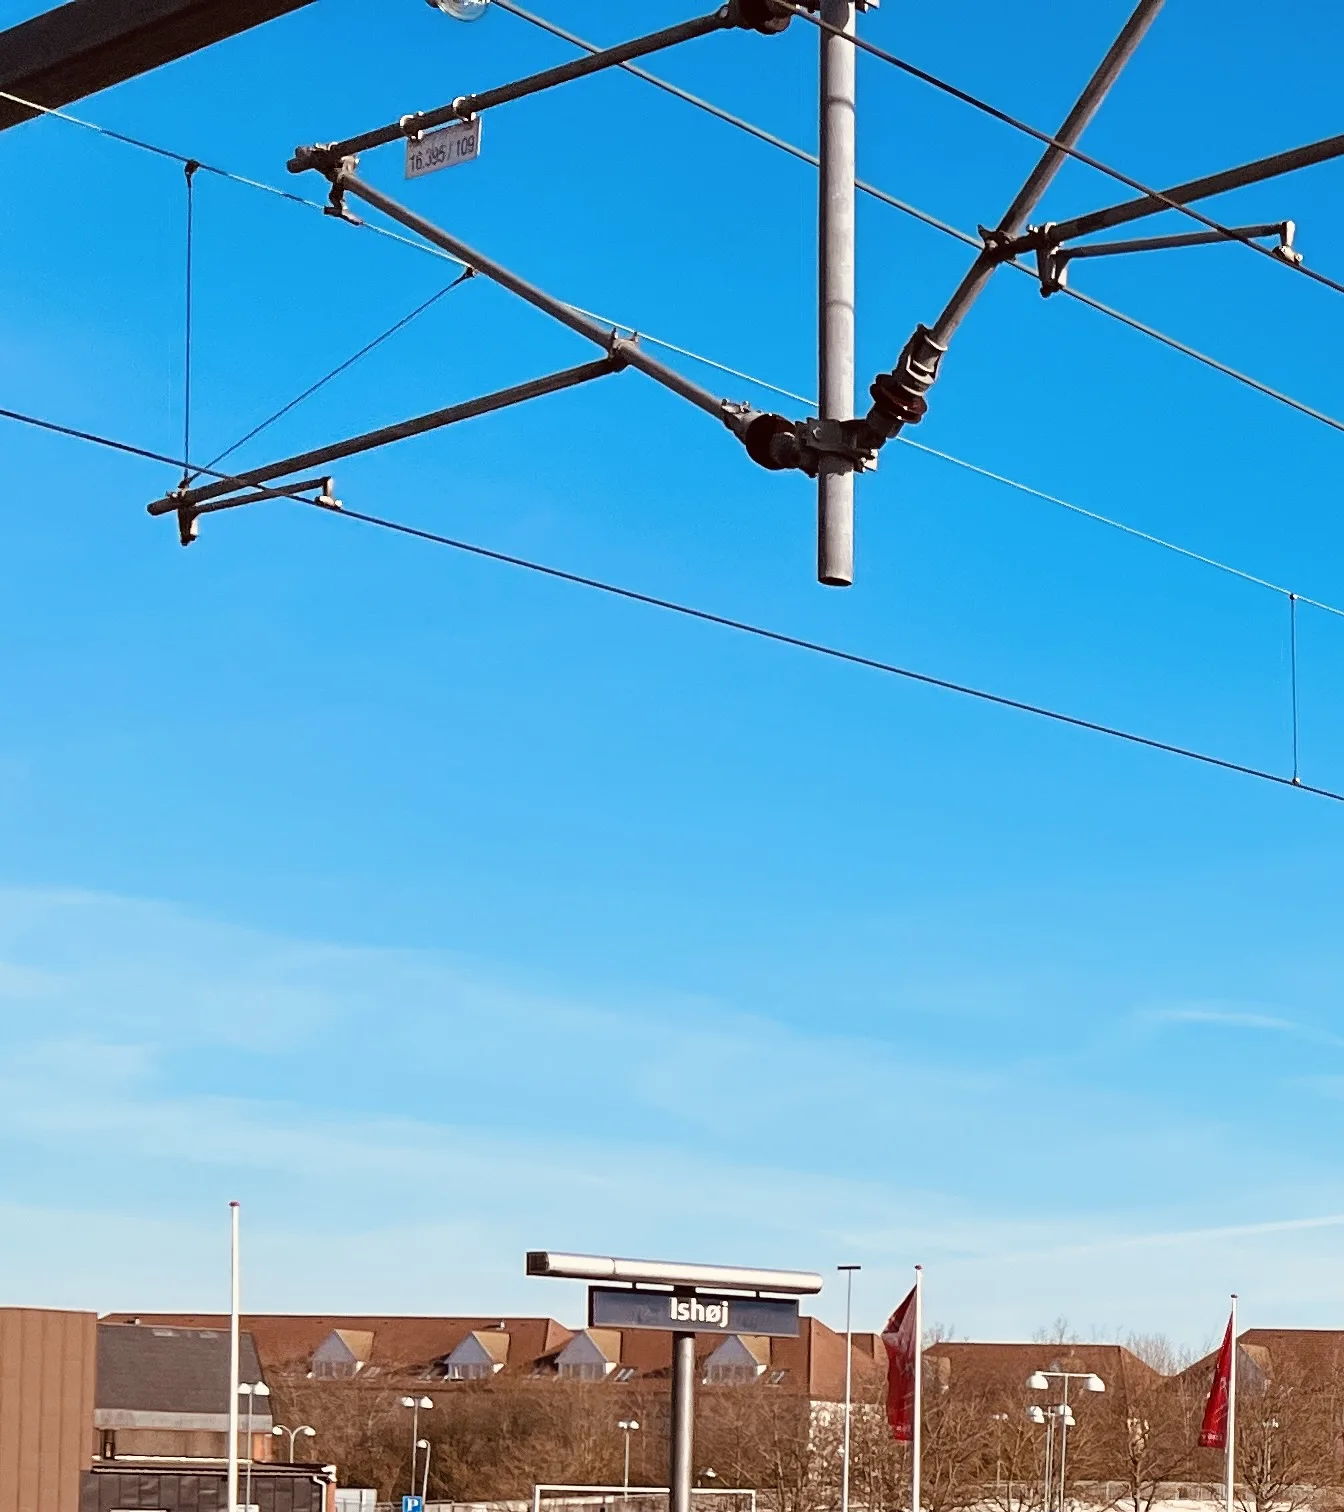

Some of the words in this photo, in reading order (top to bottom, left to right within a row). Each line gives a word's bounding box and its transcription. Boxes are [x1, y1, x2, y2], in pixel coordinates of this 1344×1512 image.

[456, 134, 475, 158] 109
[669, 1296, 729, 1328] Ishøj
[406, 1498, 418, 1512] P
